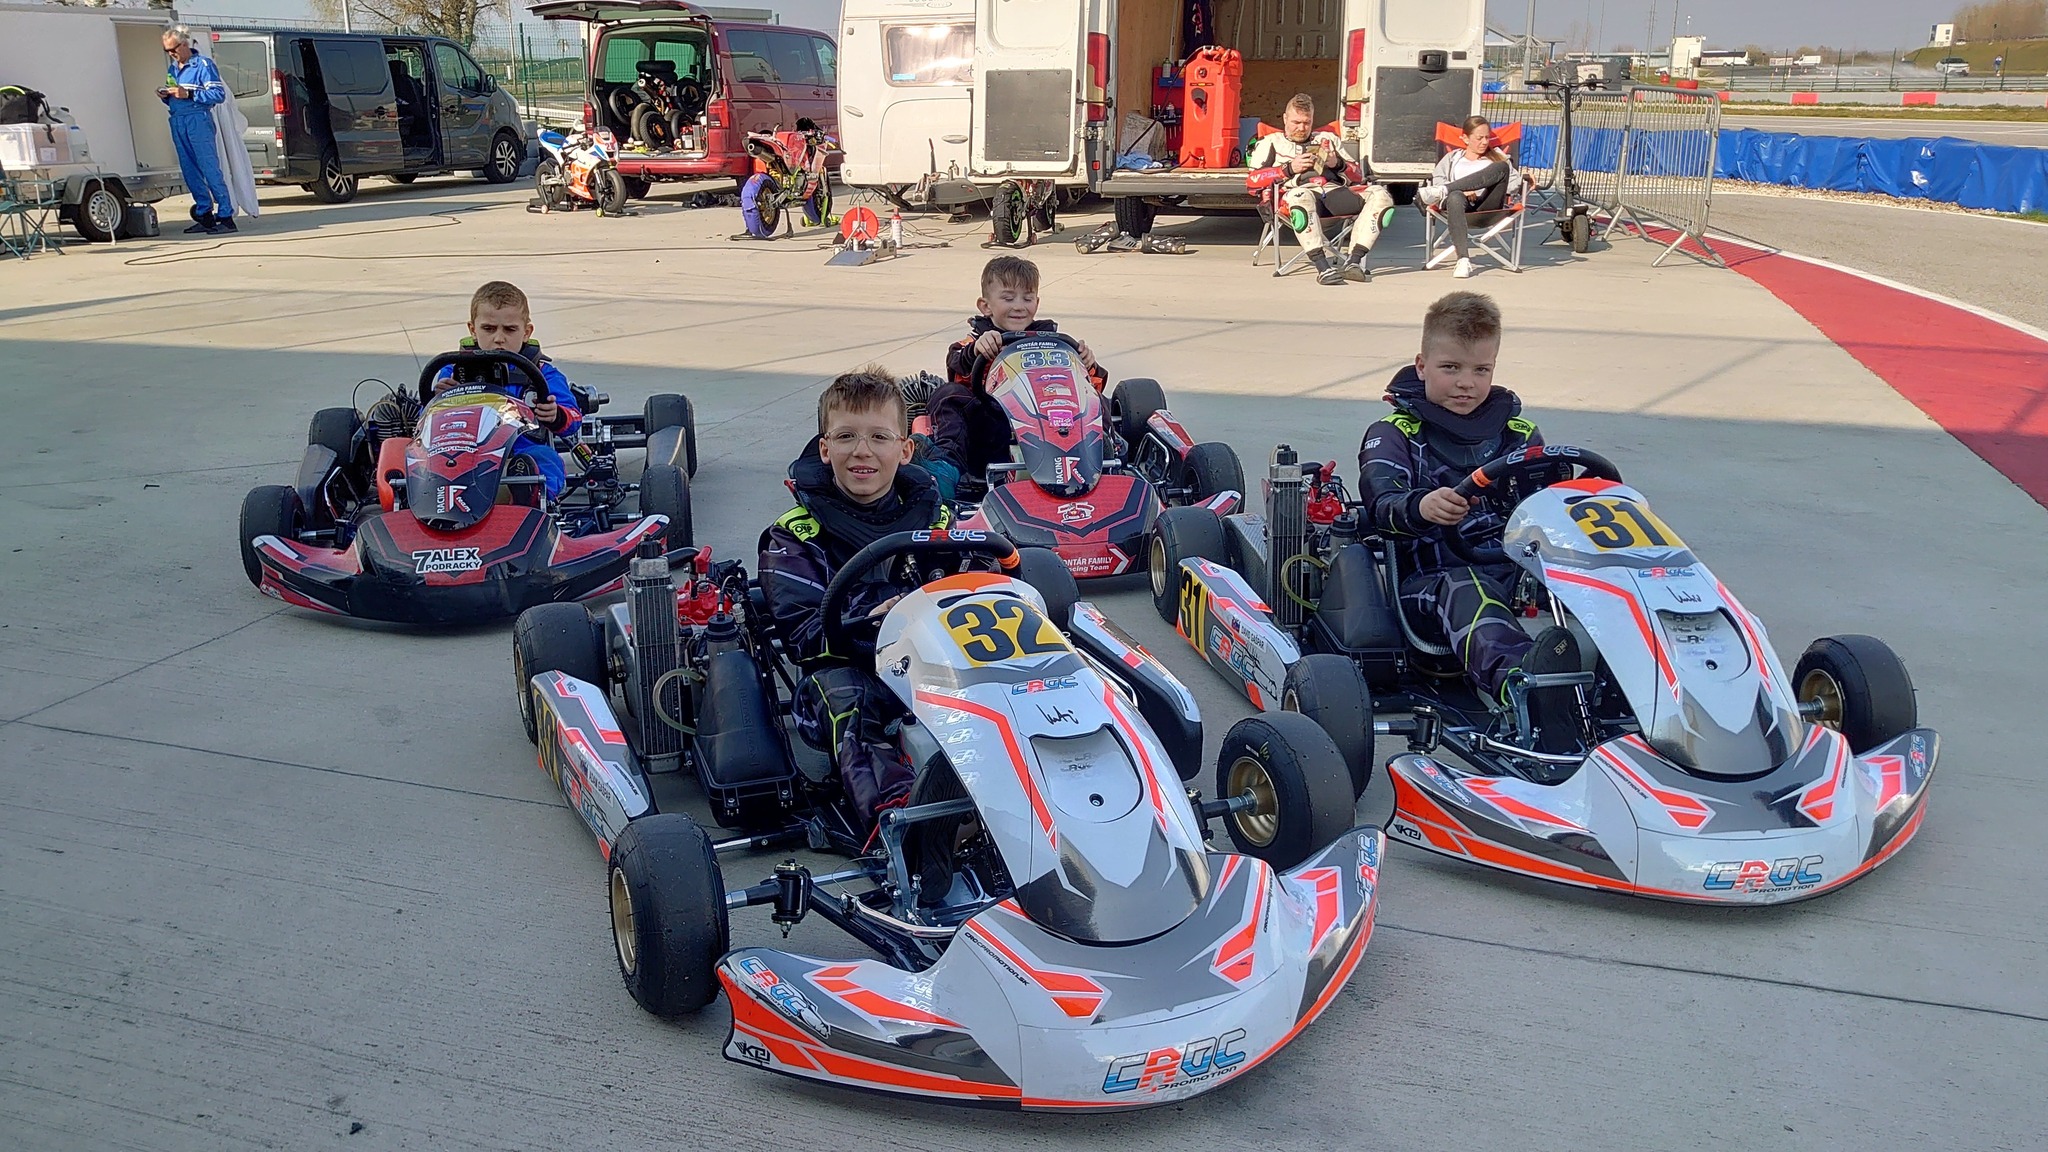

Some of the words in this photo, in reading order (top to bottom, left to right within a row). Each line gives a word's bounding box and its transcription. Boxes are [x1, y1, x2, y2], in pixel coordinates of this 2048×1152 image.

[1021, 350, 1071, 369] 33
[1054, 457, 1064, 484] RACING
[437, 486, 445, 513] RACING
[1569, 500, 1668, 548] 31
[413, 552, 431, 572] 7
[431, 549, 478, 562] ALEX
[426, 562, 480, 571] PODRACKY
[1063, 556, 1087, 566] ONTÁR
[1088, 556, 1113, 564] FAMILY
[1180, 570, 1202, 649] 31
[946, 600, 1070, 662] 32
[1743, 884, 1815, 894] PROMOTION
[1152, 1065, 1237, 1093] PROMOTION
